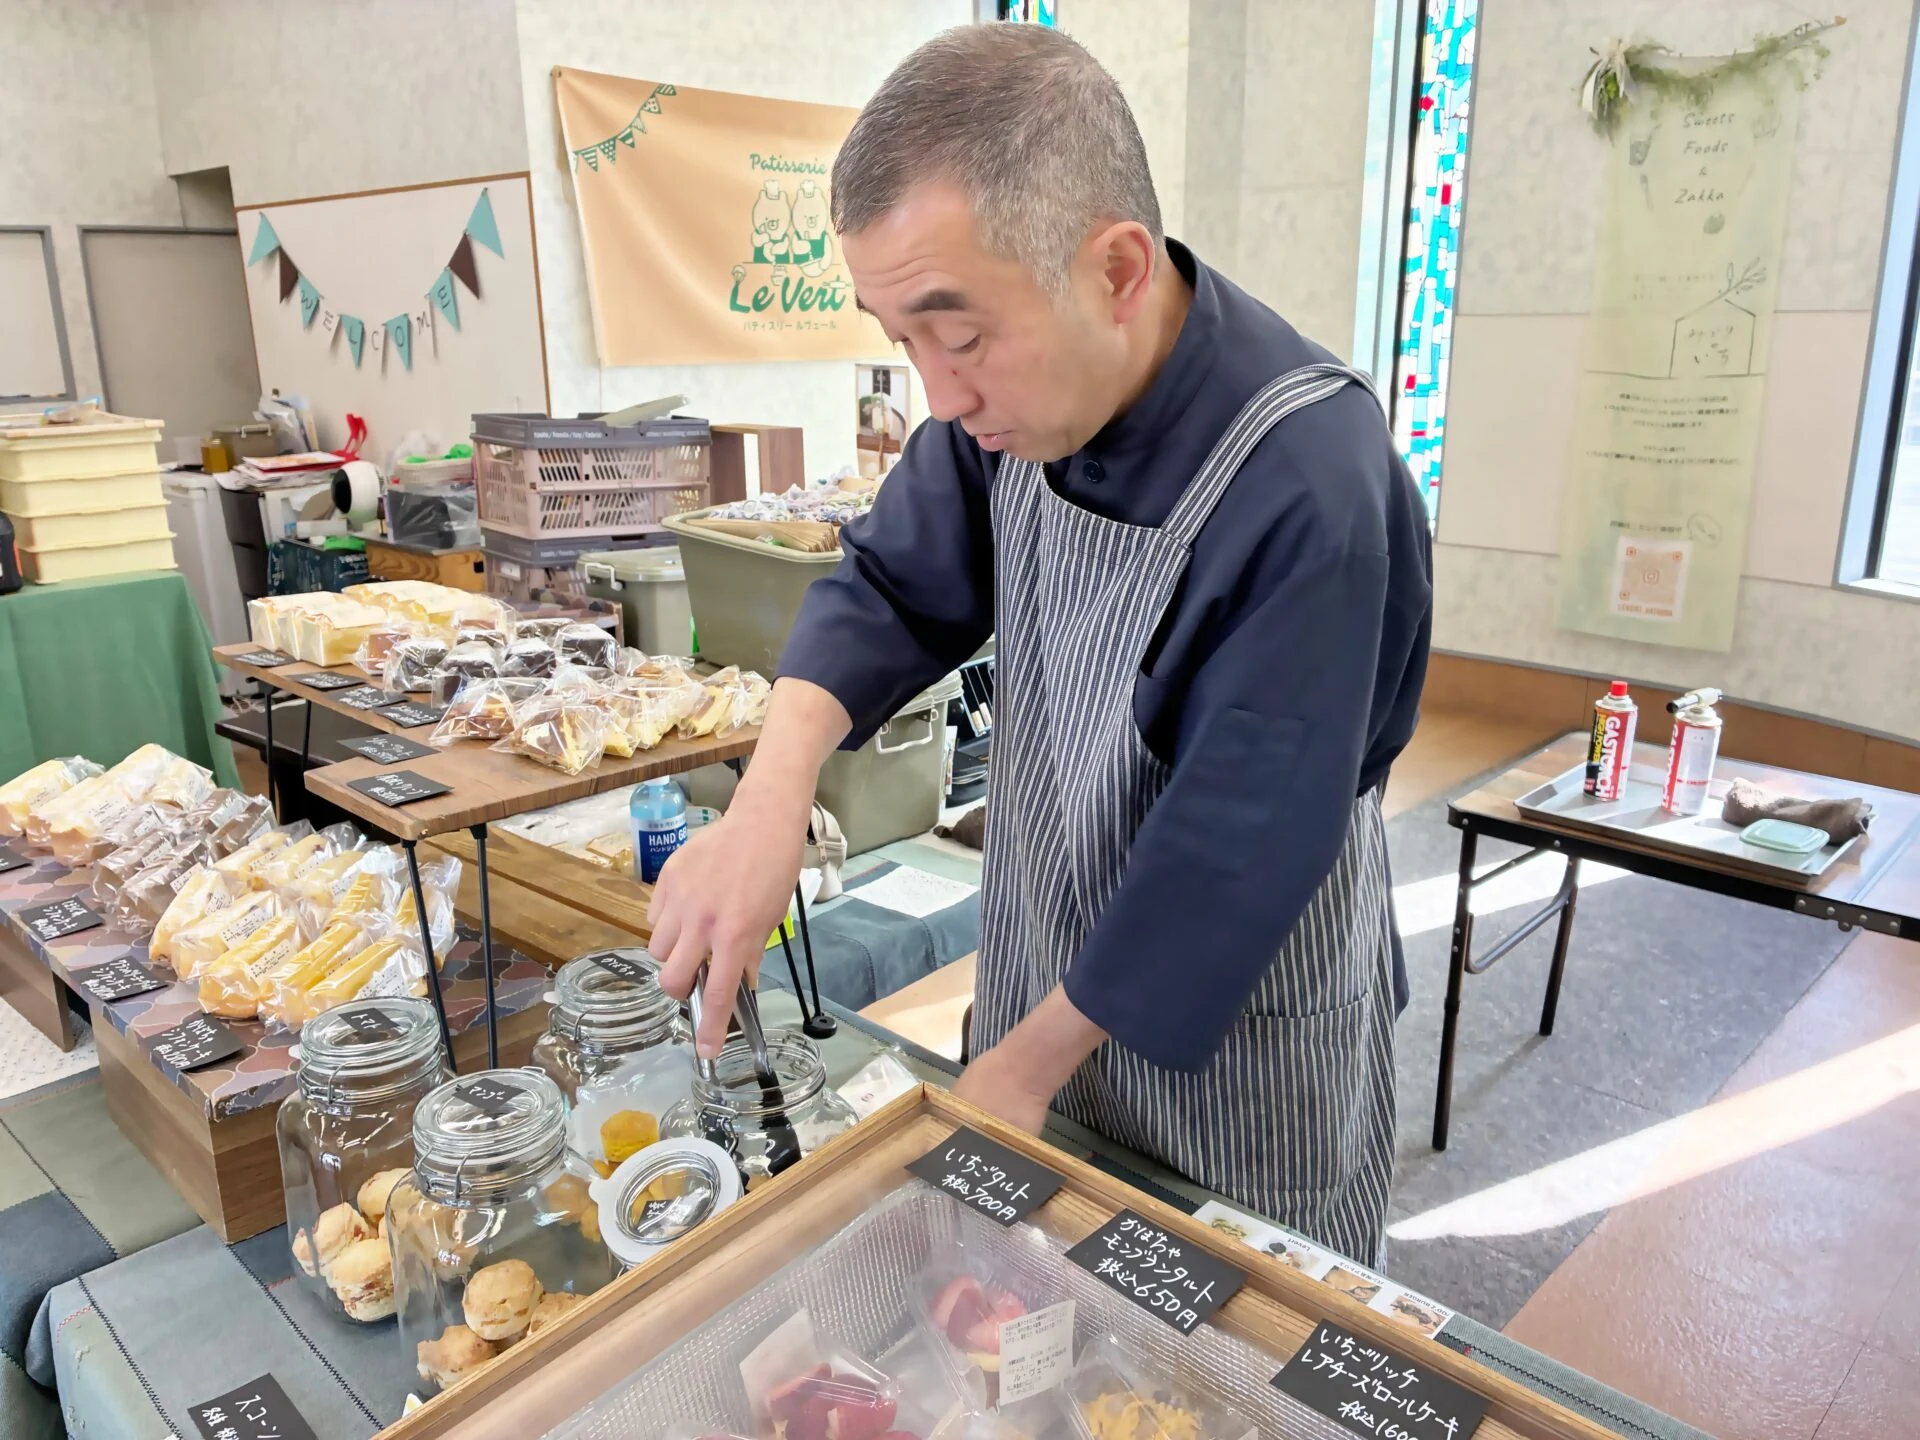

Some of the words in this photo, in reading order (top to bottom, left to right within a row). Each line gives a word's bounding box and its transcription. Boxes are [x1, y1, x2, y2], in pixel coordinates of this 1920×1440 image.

[749, 152, 827, 175] Patisserie
[729, 279, 775, 314] Le
[781, 275, 847, 314] Vert
[648, 832, 676, 847] HAND
[351, 1013, 383, 1029] トマト
[941, 1173, 1018, 1221] 税込700円
[944, 1147, 1030, 1201] いちごタルト
[1120, 1217, 1182, 1260] かぼちゃ
[1093, 1256, 1199, 1329] 税込650円
[1102, 1234, 1215, 1304] モンブランタルト
[1320, 1328, 1420, 1390] いちごリッチ
[234, 1393, 282, 1439] スコーン
[1300, 1348, 1460, 1440] レアチーズロールケーキ
